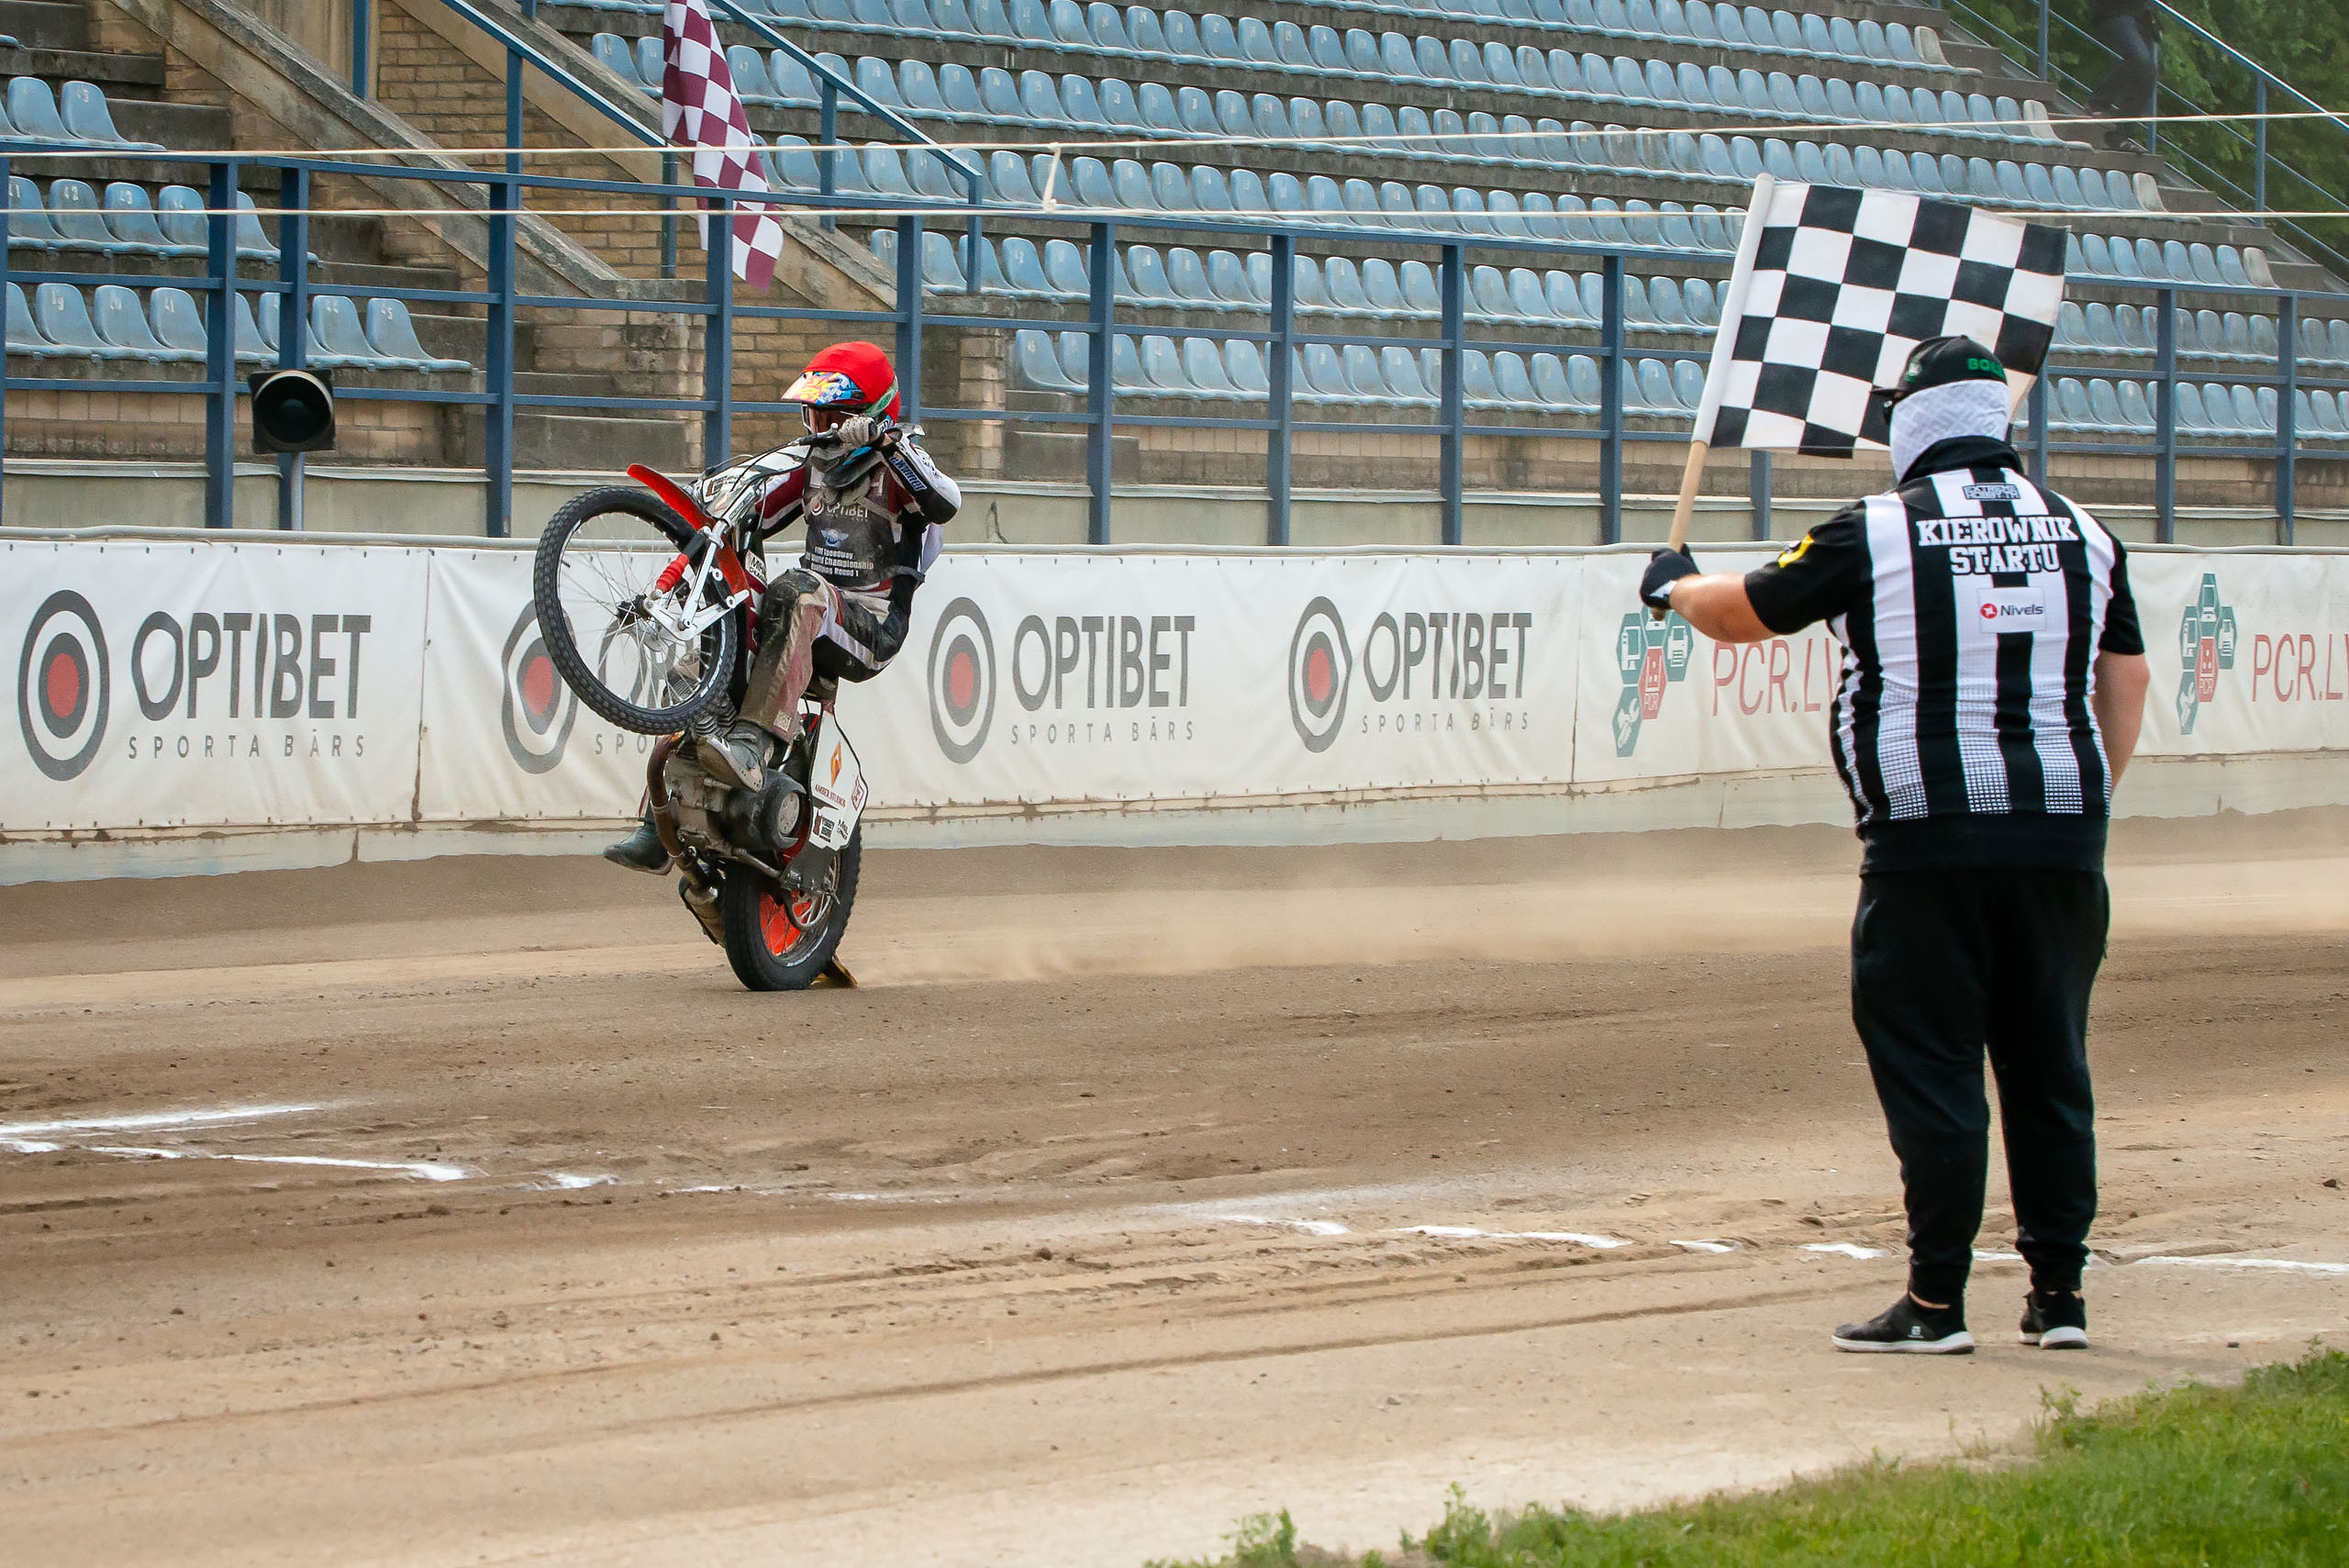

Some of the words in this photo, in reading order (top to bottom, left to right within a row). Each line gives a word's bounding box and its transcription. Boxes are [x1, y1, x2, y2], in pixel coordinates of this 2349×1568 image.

[1915, 516, 2080, 547] KIEROWNIK
[1949, 542, 2062, 574] STARTU
[1999, 603, 2044, 617] Nivels
[131, 610, 372, 721] OPTIBET
[1011, 614, 1196, 712] OPTIBET
[1363, 611, 1532, 703] OPTIBET
[2252, 633, 2349, 703] PCR.L
[1010, 722, 1113, 745] SPORTA
[1131, 716, 1194, 742] BĀRS
[1361, 713, 1454, 734] SPORTA
[128, 735, 261, 760] SPORTA
[284, 728, 365, 759] BĀRS
